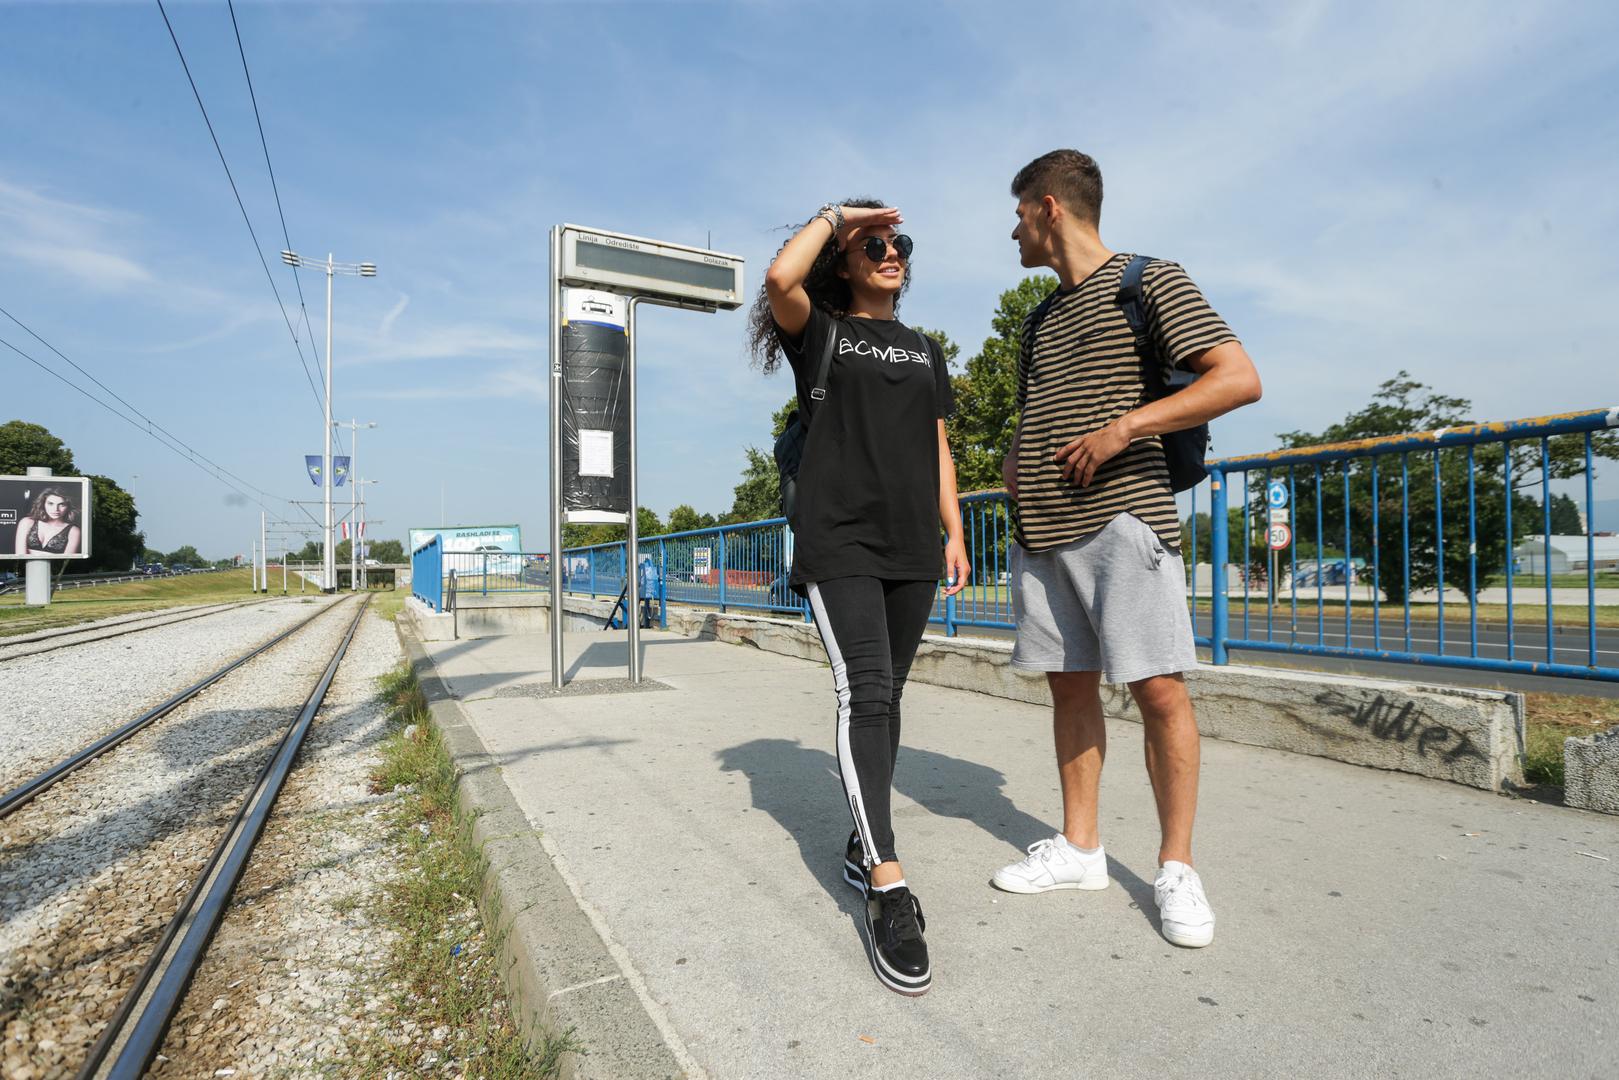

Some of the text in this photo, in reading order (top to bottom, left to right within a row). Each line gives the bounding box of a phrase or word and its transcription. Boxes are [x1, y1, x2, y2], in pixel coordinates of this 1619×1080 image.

[578, 233, 598, 243] Linija
[704, 256, 728, 266] Dolazak
[1271, 529, 1285, 542] 50
